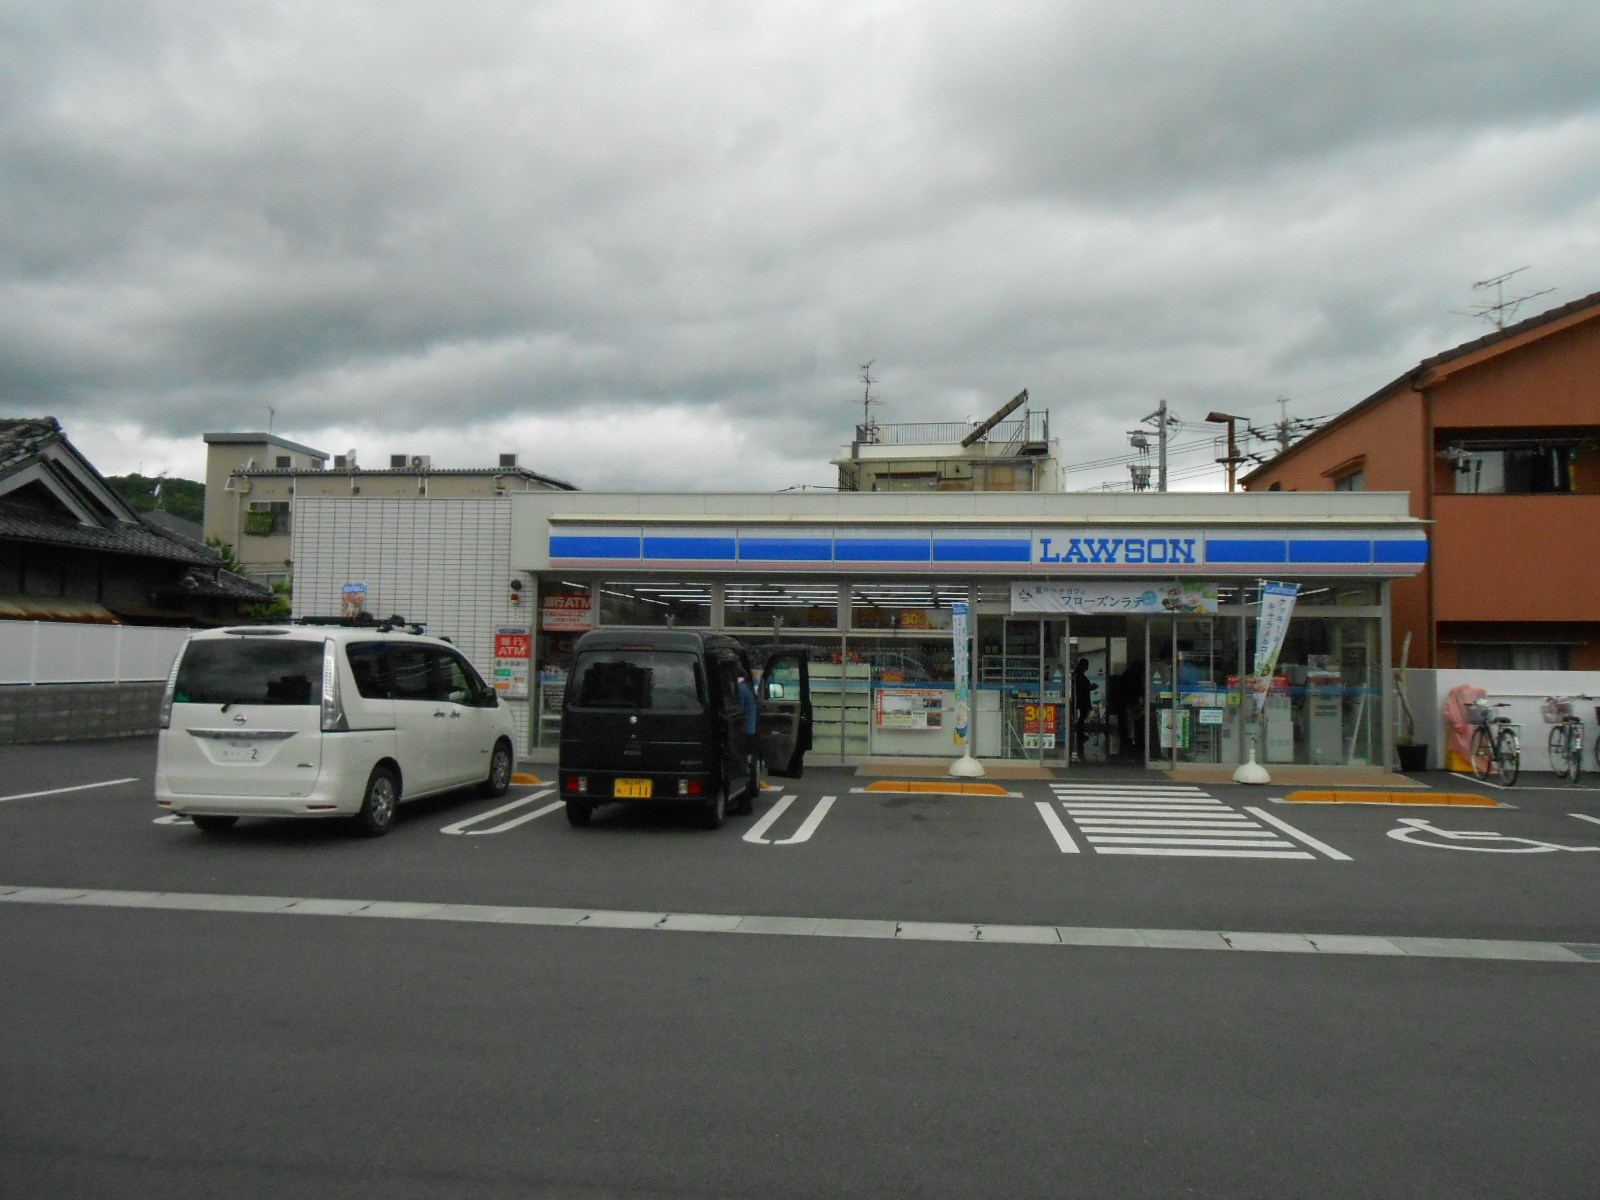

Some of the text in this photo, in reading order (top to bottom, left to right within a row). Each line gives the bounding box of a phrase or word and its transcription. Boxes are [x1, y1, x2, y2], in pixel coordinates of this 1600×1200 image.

[1040, 538, 1196, 563] LAWSON
[1061, 594, 1144, 609] フローズンラテ
[498, 646, 526, 656] ATM
